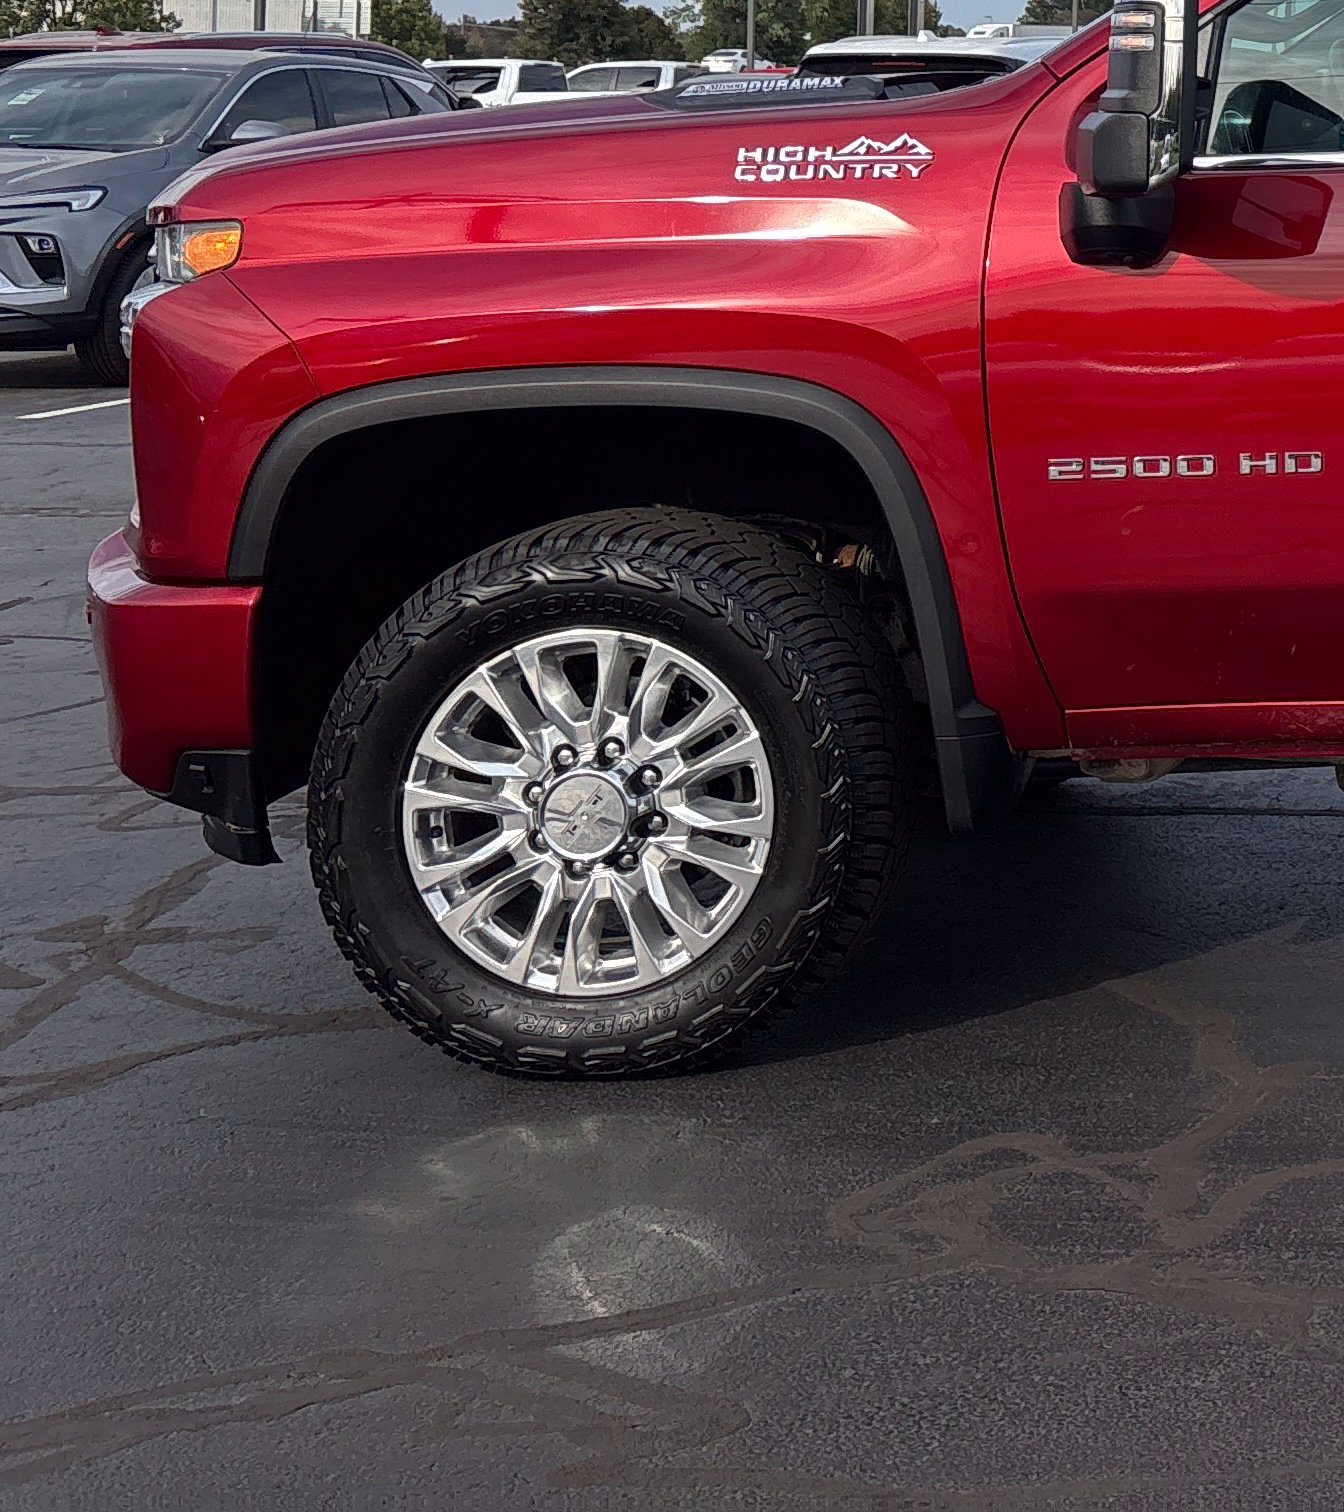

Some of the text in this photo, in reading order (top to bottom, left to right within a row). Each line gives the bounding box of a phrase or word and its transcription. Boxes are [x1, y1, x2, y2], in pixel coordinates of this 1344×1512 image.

[746, 76, 846, 93] DURAMAX
[736, 146, 835, 163] HIGH
[733, 162, 930, 182] COUNTRY
[1047, 450, 1324, 481] 2500 HD
[455, 590, 688, 648] YOKOHAMA
[516, 914, 773, 1039] GEOLANDAR
